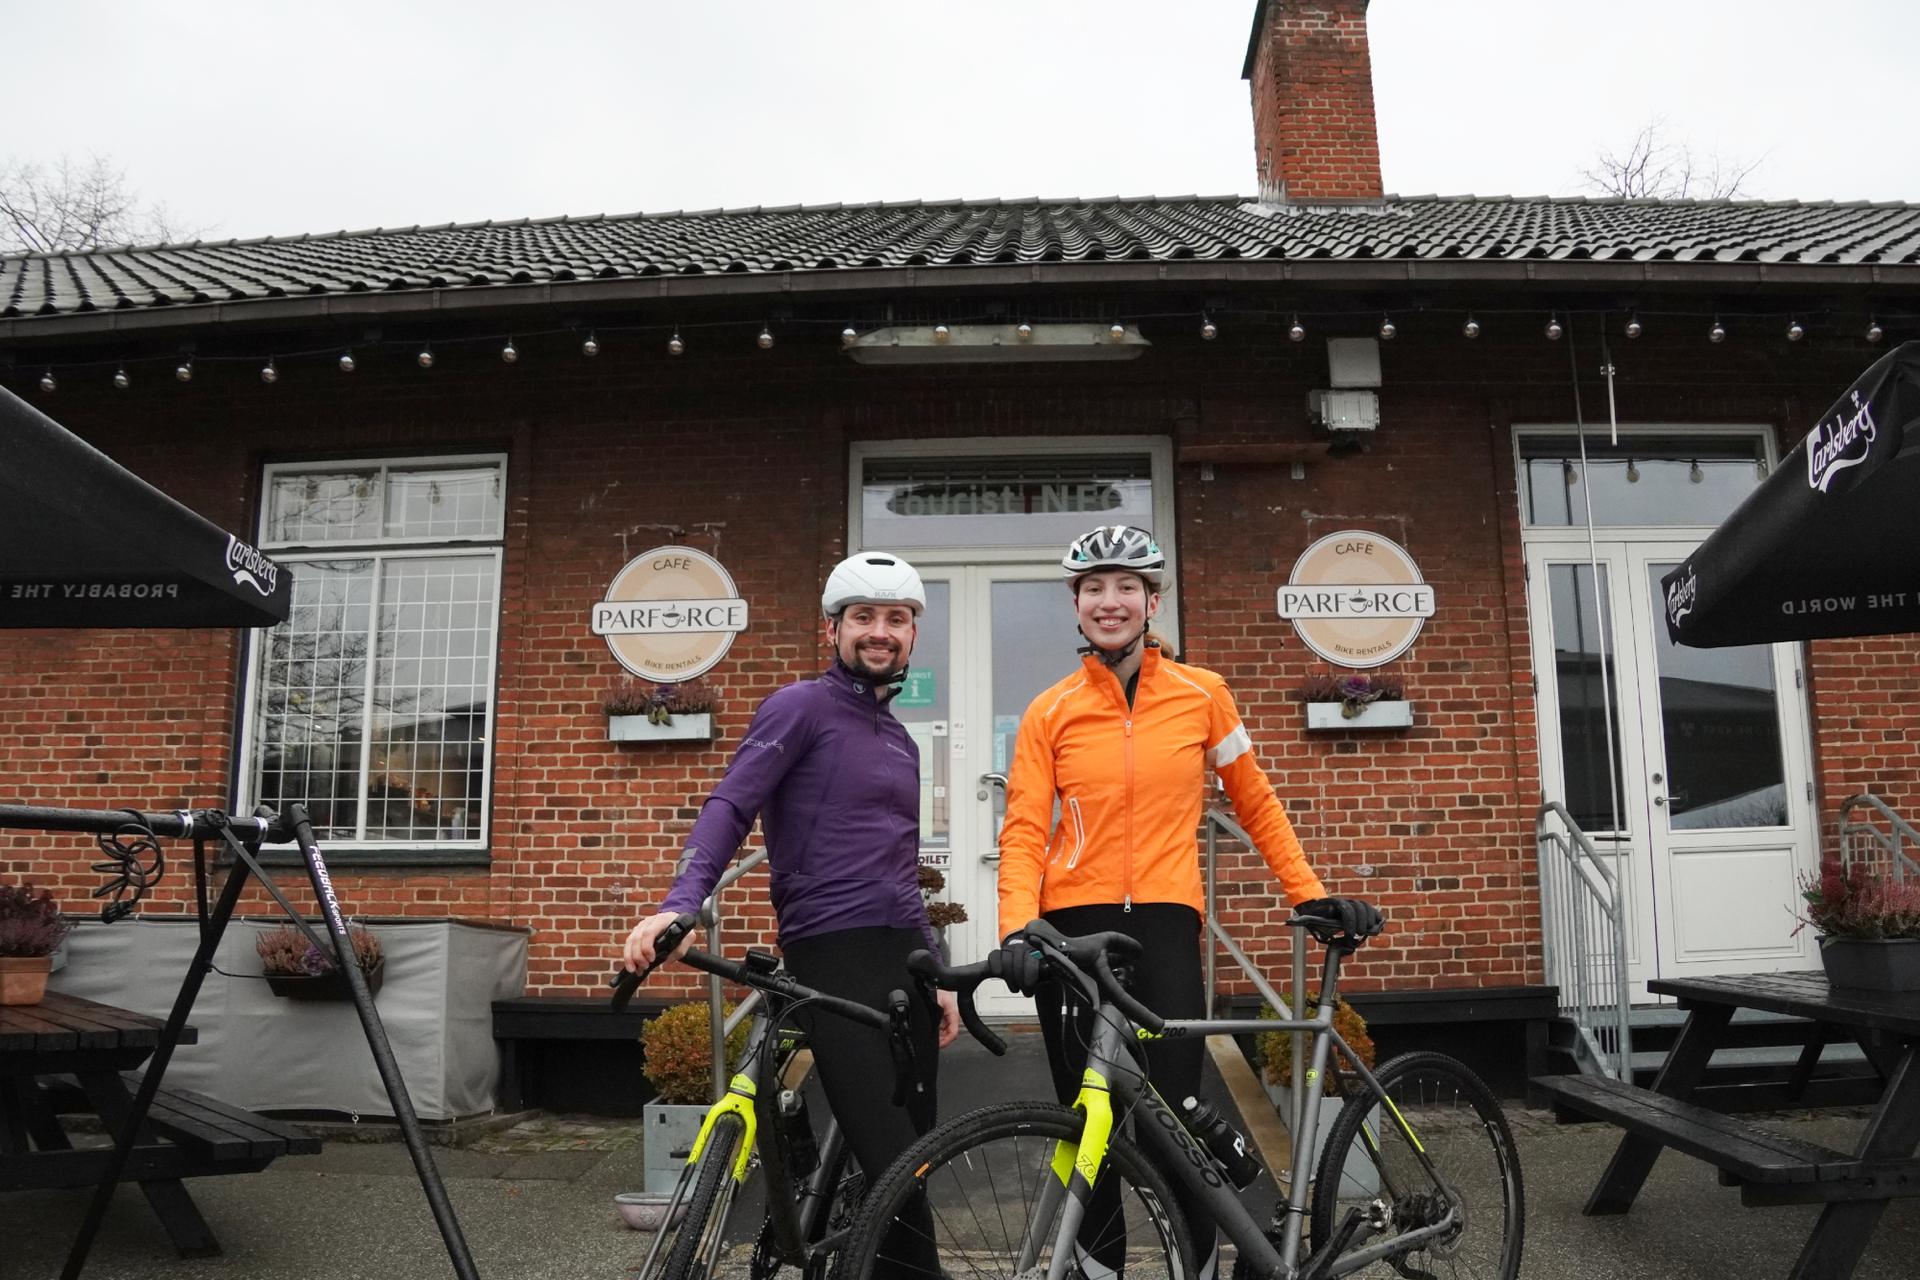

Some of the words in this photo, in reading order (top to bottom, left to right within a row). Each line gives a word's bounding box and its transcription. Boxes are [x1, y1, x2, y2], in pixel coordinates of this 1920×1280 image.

[1806, 401, 1876, 493] Carlsberg
[226, 534, 278, 596] Carlsberg
[1668, 574, 1697, 628] Carlsberg
[644, 659, 663, 670] BIKE
[665, 655, 702, 670] RENTALS
[1334, 644, 1354, 655] BIKE
[1356, 640, 1392, 656] RENTALS
[309, 845, 341, 910] FEEDBACK
[918, 855, 949, 865] OILET
[1133, 1084, 1222, 1189] MOSSO
